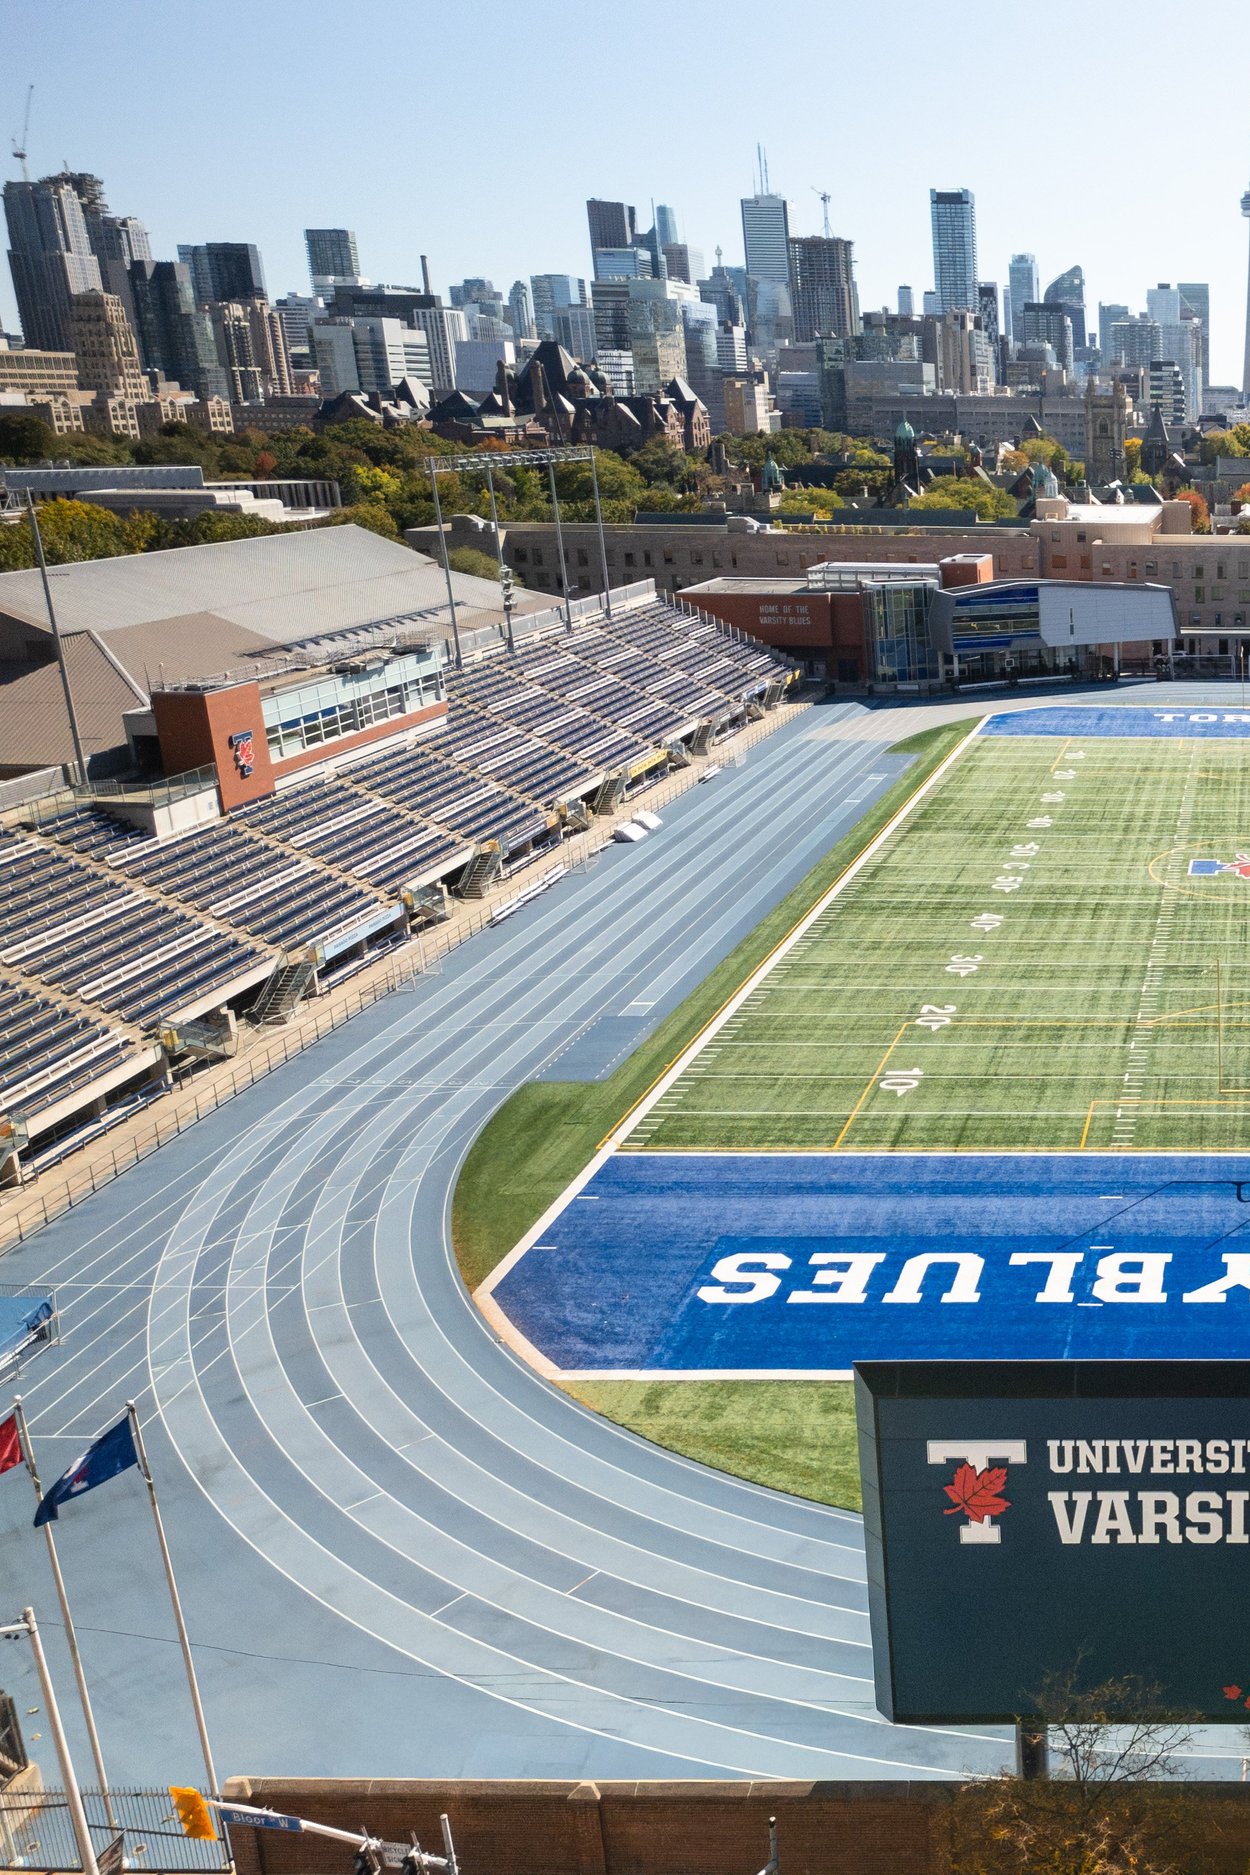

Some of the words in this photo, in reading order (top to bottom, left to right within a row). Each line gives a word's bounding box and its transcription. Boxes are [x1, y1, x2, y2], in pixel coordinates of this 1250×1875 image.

[759, 605, 779, 614] HOME
[782, 605, 792, 614] OF
[796, 605, 809, 614] THE
[759, 616, 787, 625] VARSITY
[788, 616, 811, 625] BLUES
[1009, 844, 1040, 856] 50
[1002, 862, 1030, 870] C
[991, 876, 1024, 890] 50
[970, 912, 1004, 928] 40
[945, 954, 983, 973] 30
[915, 1004, 957, 1026] 20
[879, 1067, 925, 1090] 10
[697, 1252, 1172, 1304] BLUES
[927, 1439, 1027, 1545] T
[232, 1812, 266, 1825] Bloor
[278, 1818, 289, 1828] W
